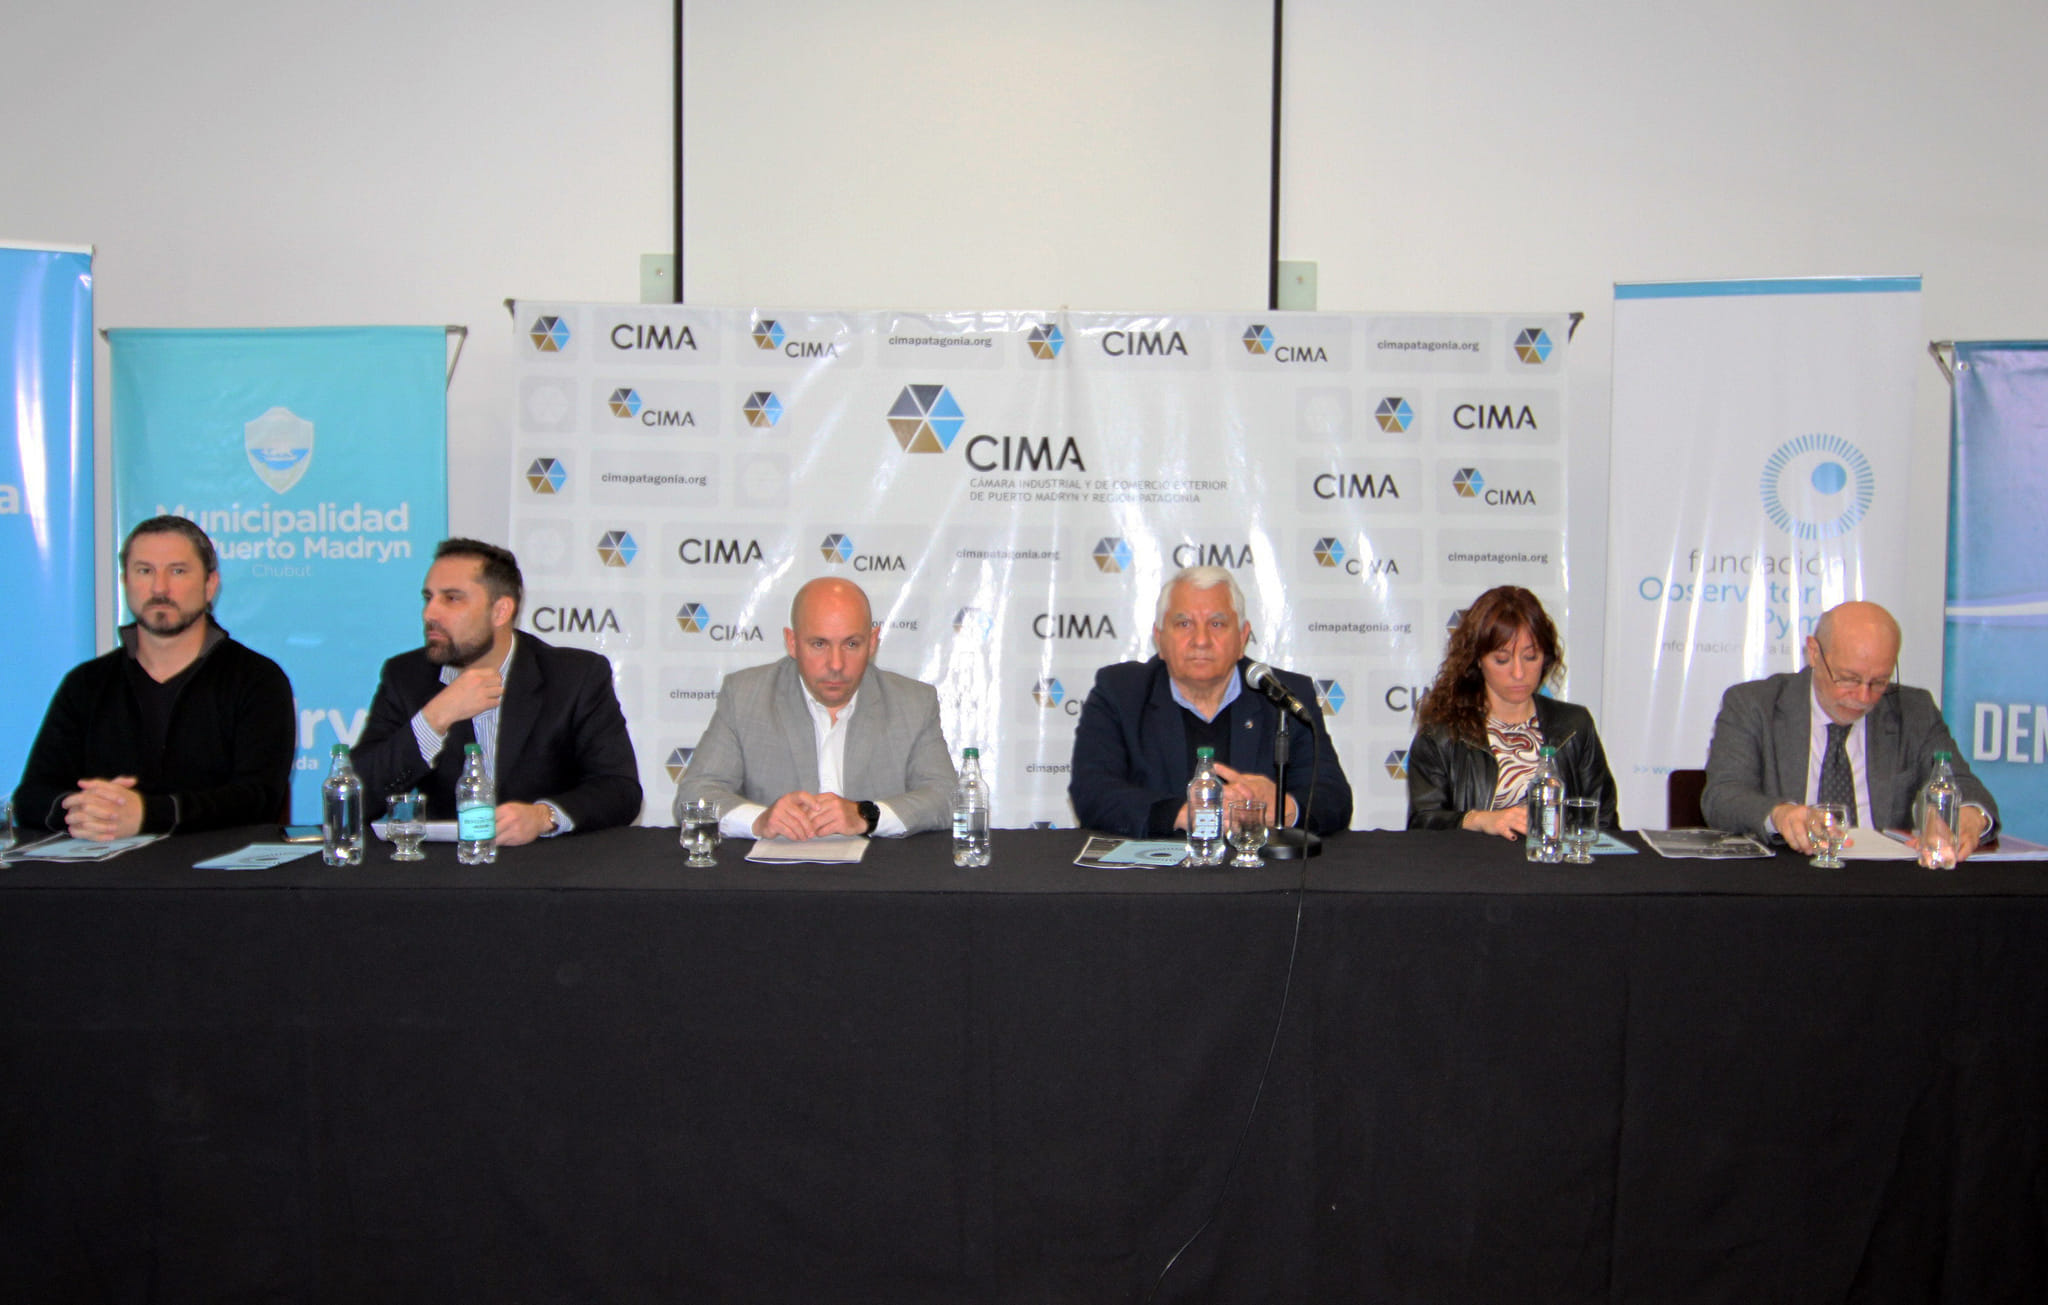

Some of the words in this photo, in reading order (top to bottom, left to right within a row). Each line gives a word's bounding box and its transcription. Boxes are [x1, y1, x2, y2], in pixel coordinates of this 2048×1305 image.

[611, 323, 697, 350] CIMA
[888, 336, 993, 348] cimapatagonia.org
[1102, 331, 1189, 356] CIMA
[785, 341, 840, 358] CIMA
[1275, 346, 1328, 363] CIMA
[1377, 340, 1479, 352] cimapatagonia.org
[641, 410, 696, 427] CIMA
[1453, 404, 1538, 430] CIMA
[965, 434, 1087, 472] CIMA
[601, 473, 707, 486] cimapatagonia.org
[1313, 474, 1400, 500] CIMA
[1485, 490, 1537, 506] CIMA
[303, 536, 412, 563] Madryn
[678, 538, 764, 565] CIMA
[1173, 543, 1256, 569] CIMA
[1448, 552, 1548, 564] cimapatagonia.org
[252, 564, 311, 578] Chubut
[853, 555, 906, 572] CIMA
[532, 606, 621, 633] CIMA
[1033, 613, 1118, 640] CIMA
[1308, 621, 1412, 634] cimapatagonia.org
